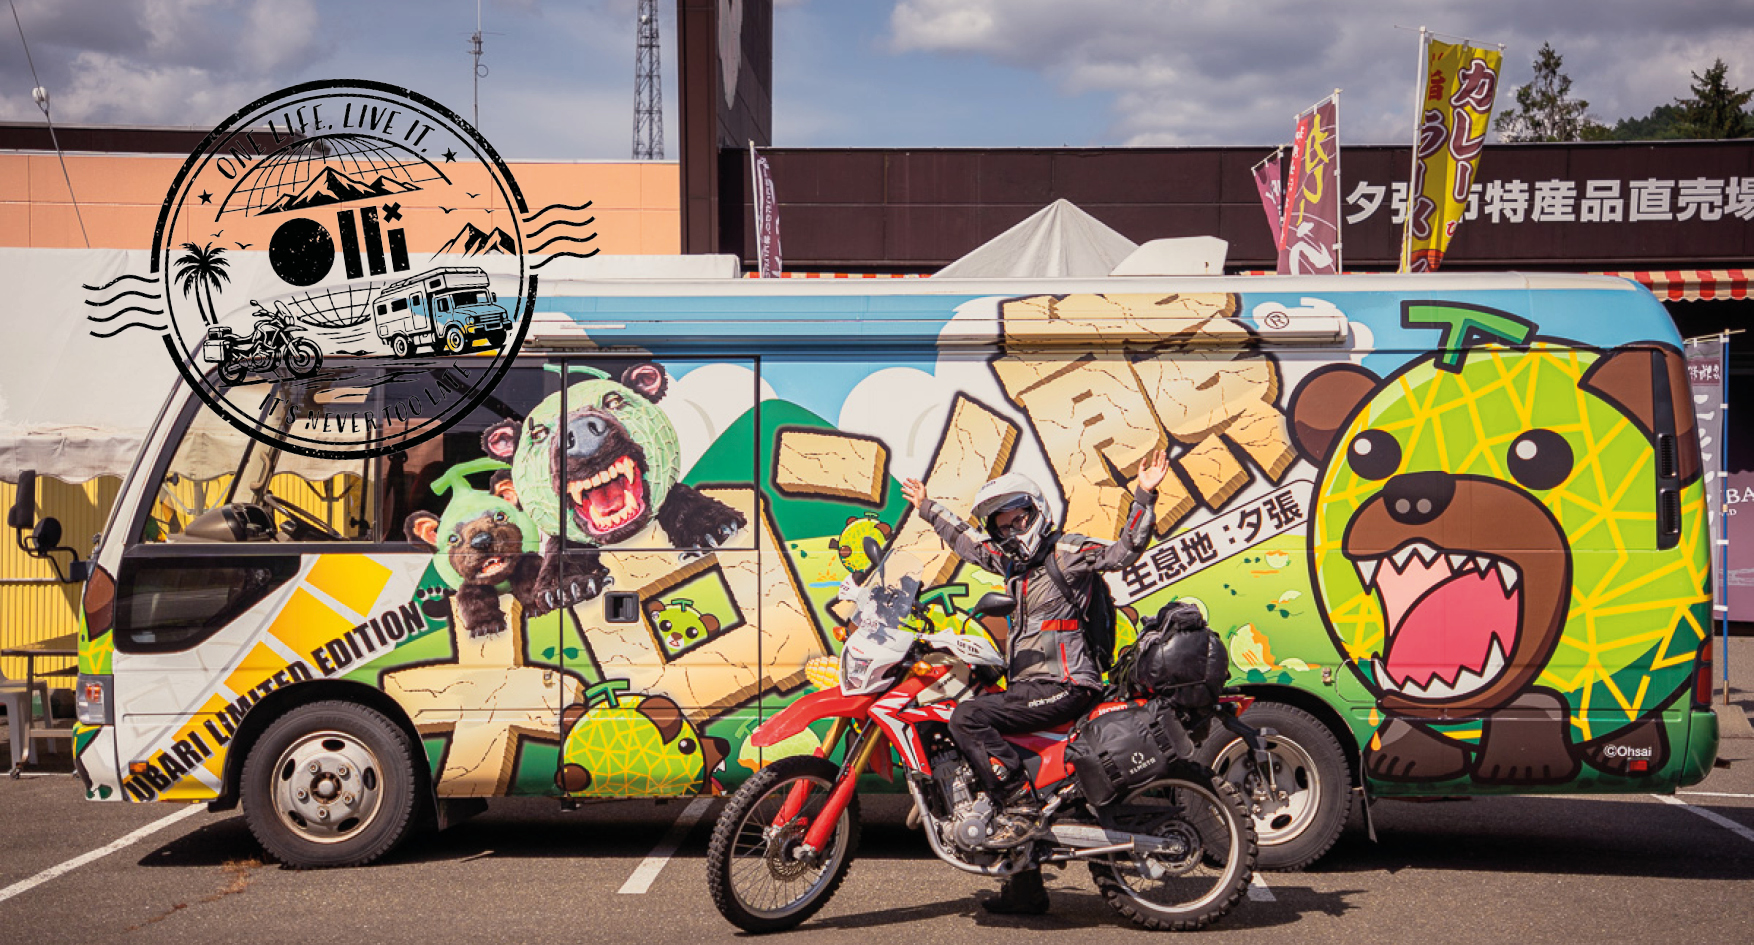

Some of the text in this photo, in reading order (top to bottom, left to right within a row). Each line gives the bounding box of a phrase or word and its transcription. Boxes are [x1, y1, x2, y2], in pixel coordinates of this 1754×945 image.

[1450, 58, 1497, 204] カレー
[311, 600, 427, 678] EDITION
